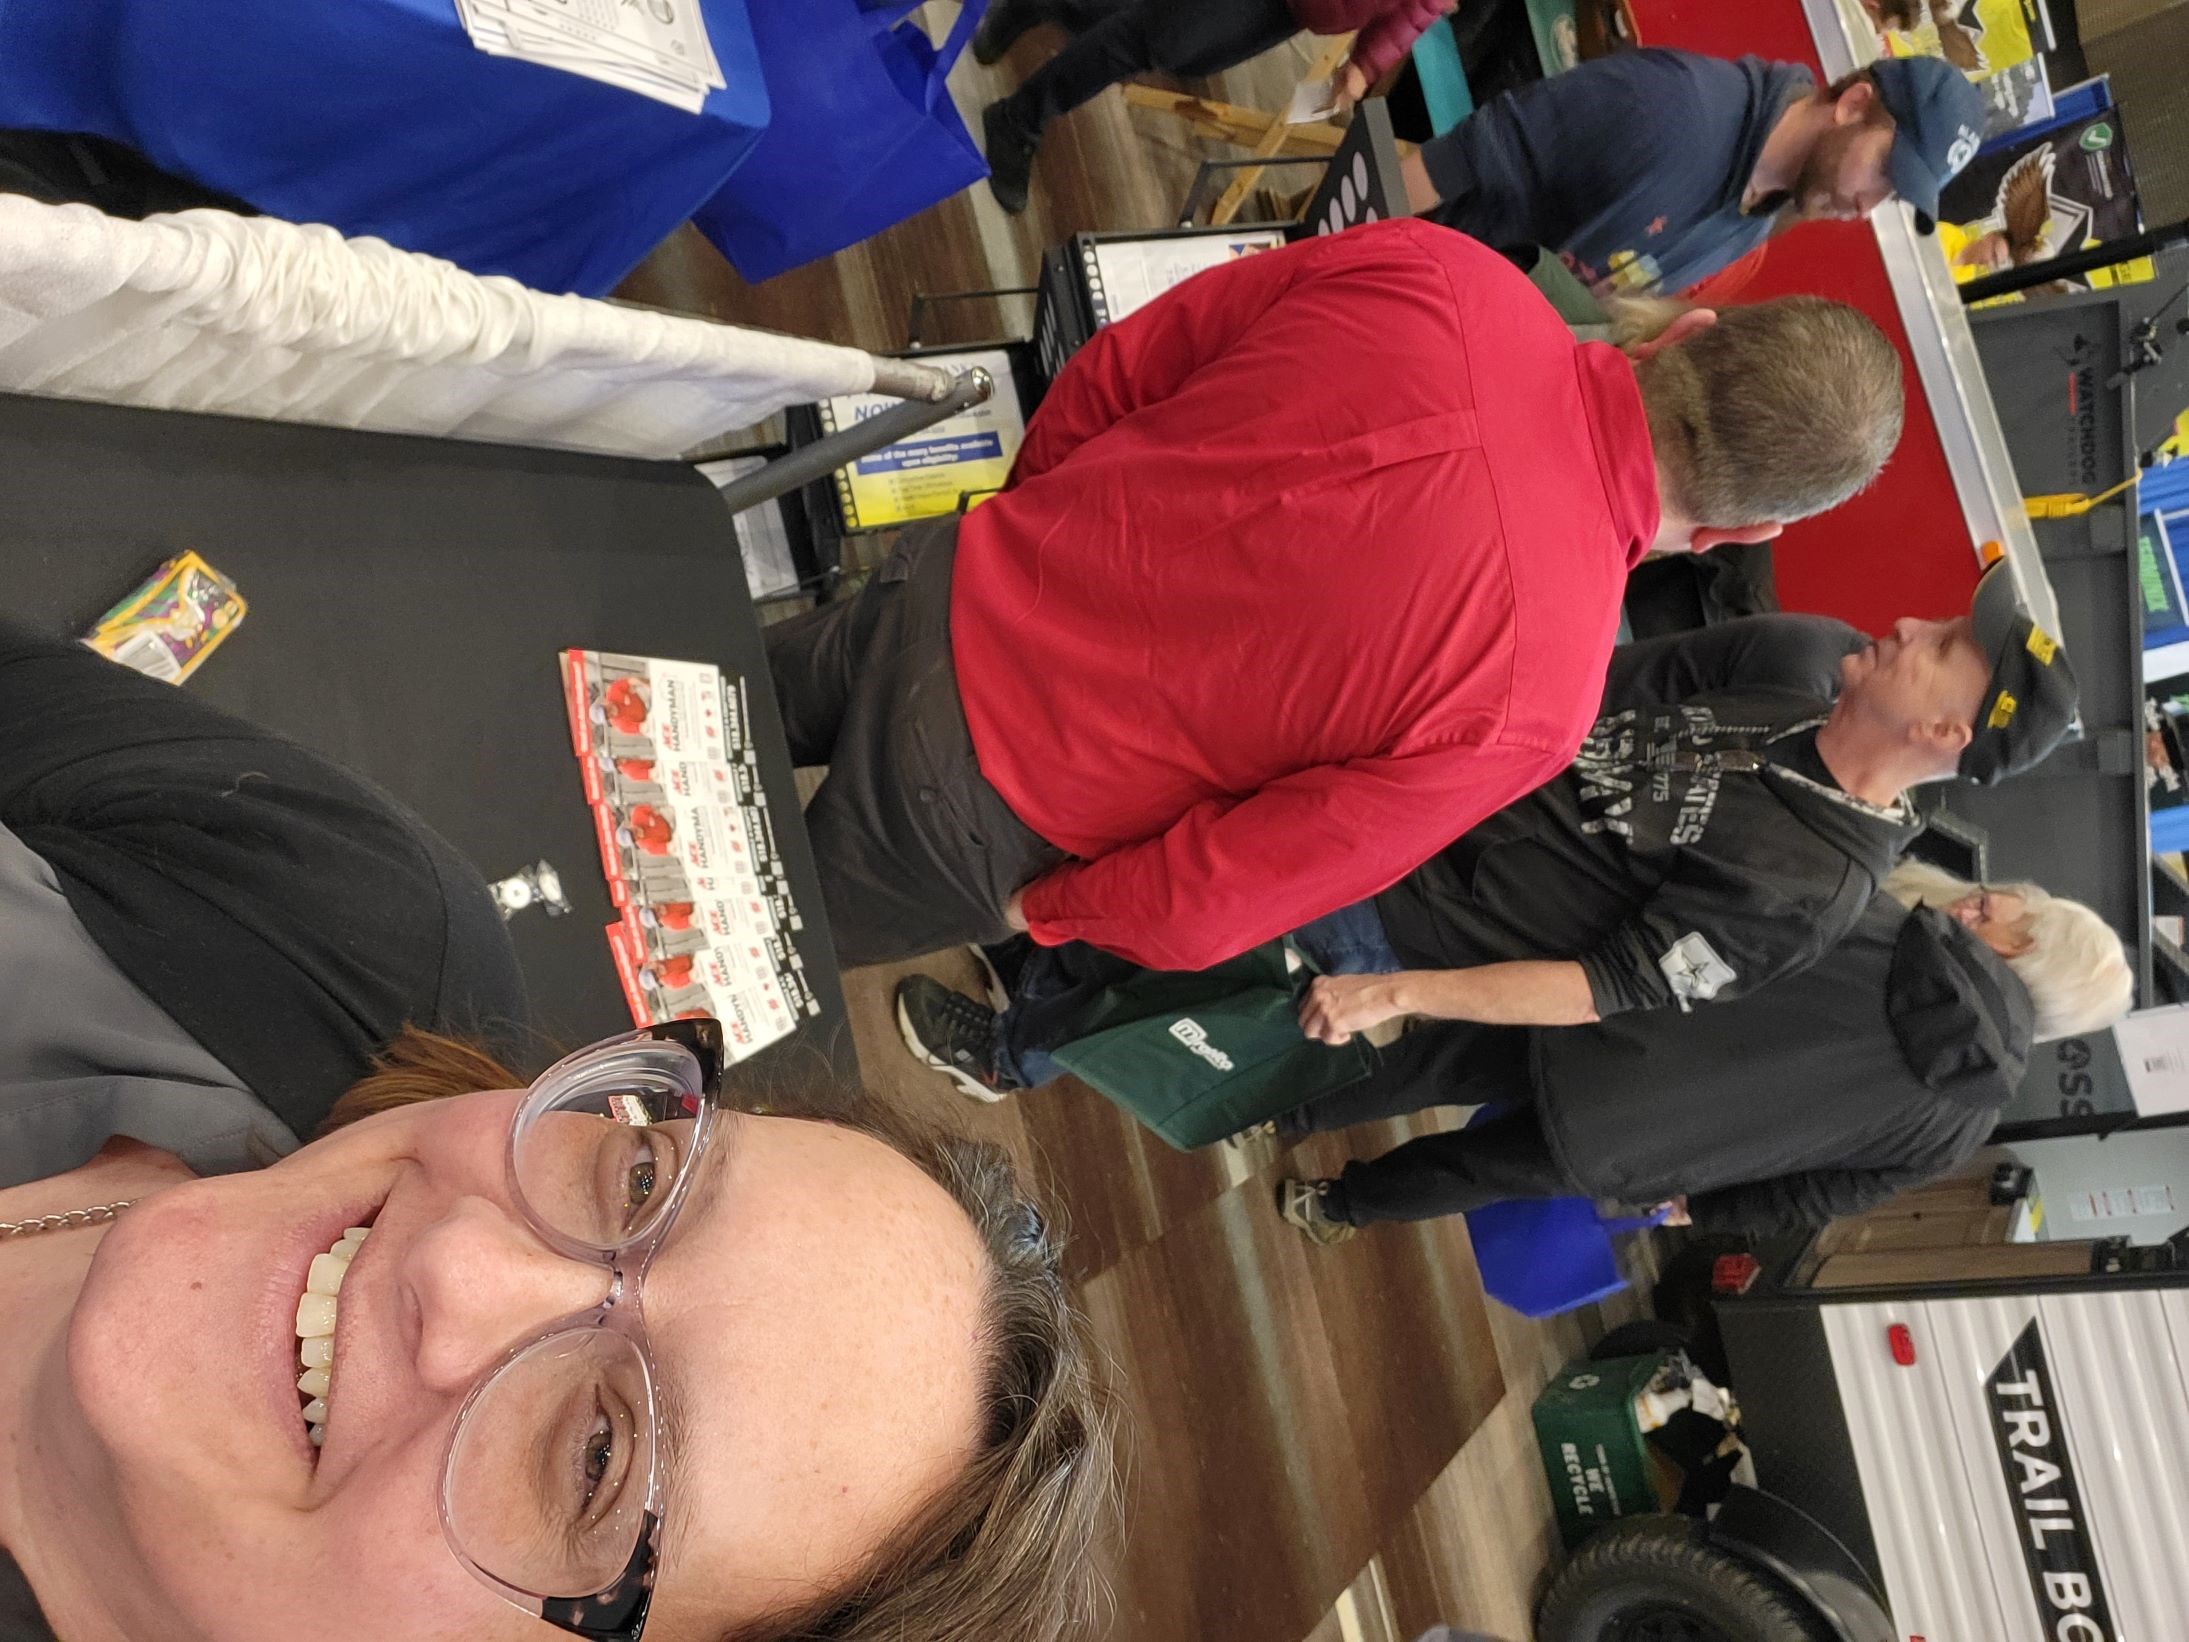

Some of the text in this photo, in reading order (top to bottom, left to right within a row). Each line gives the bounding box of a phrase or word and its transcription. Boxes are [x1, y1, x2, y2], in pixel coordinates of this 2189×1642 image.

[2079, 368, 2096, 484] WATCHDOG
[667, 679, 681, 752] HANDYMAN
[1653, 773, 1670, 802] 775
[1561, 1443, 1593, 1514] RECYCLE
[1585, 1468, 1604, 1492] WE
[1995, 1369, 2075, 1549] TRAIL
